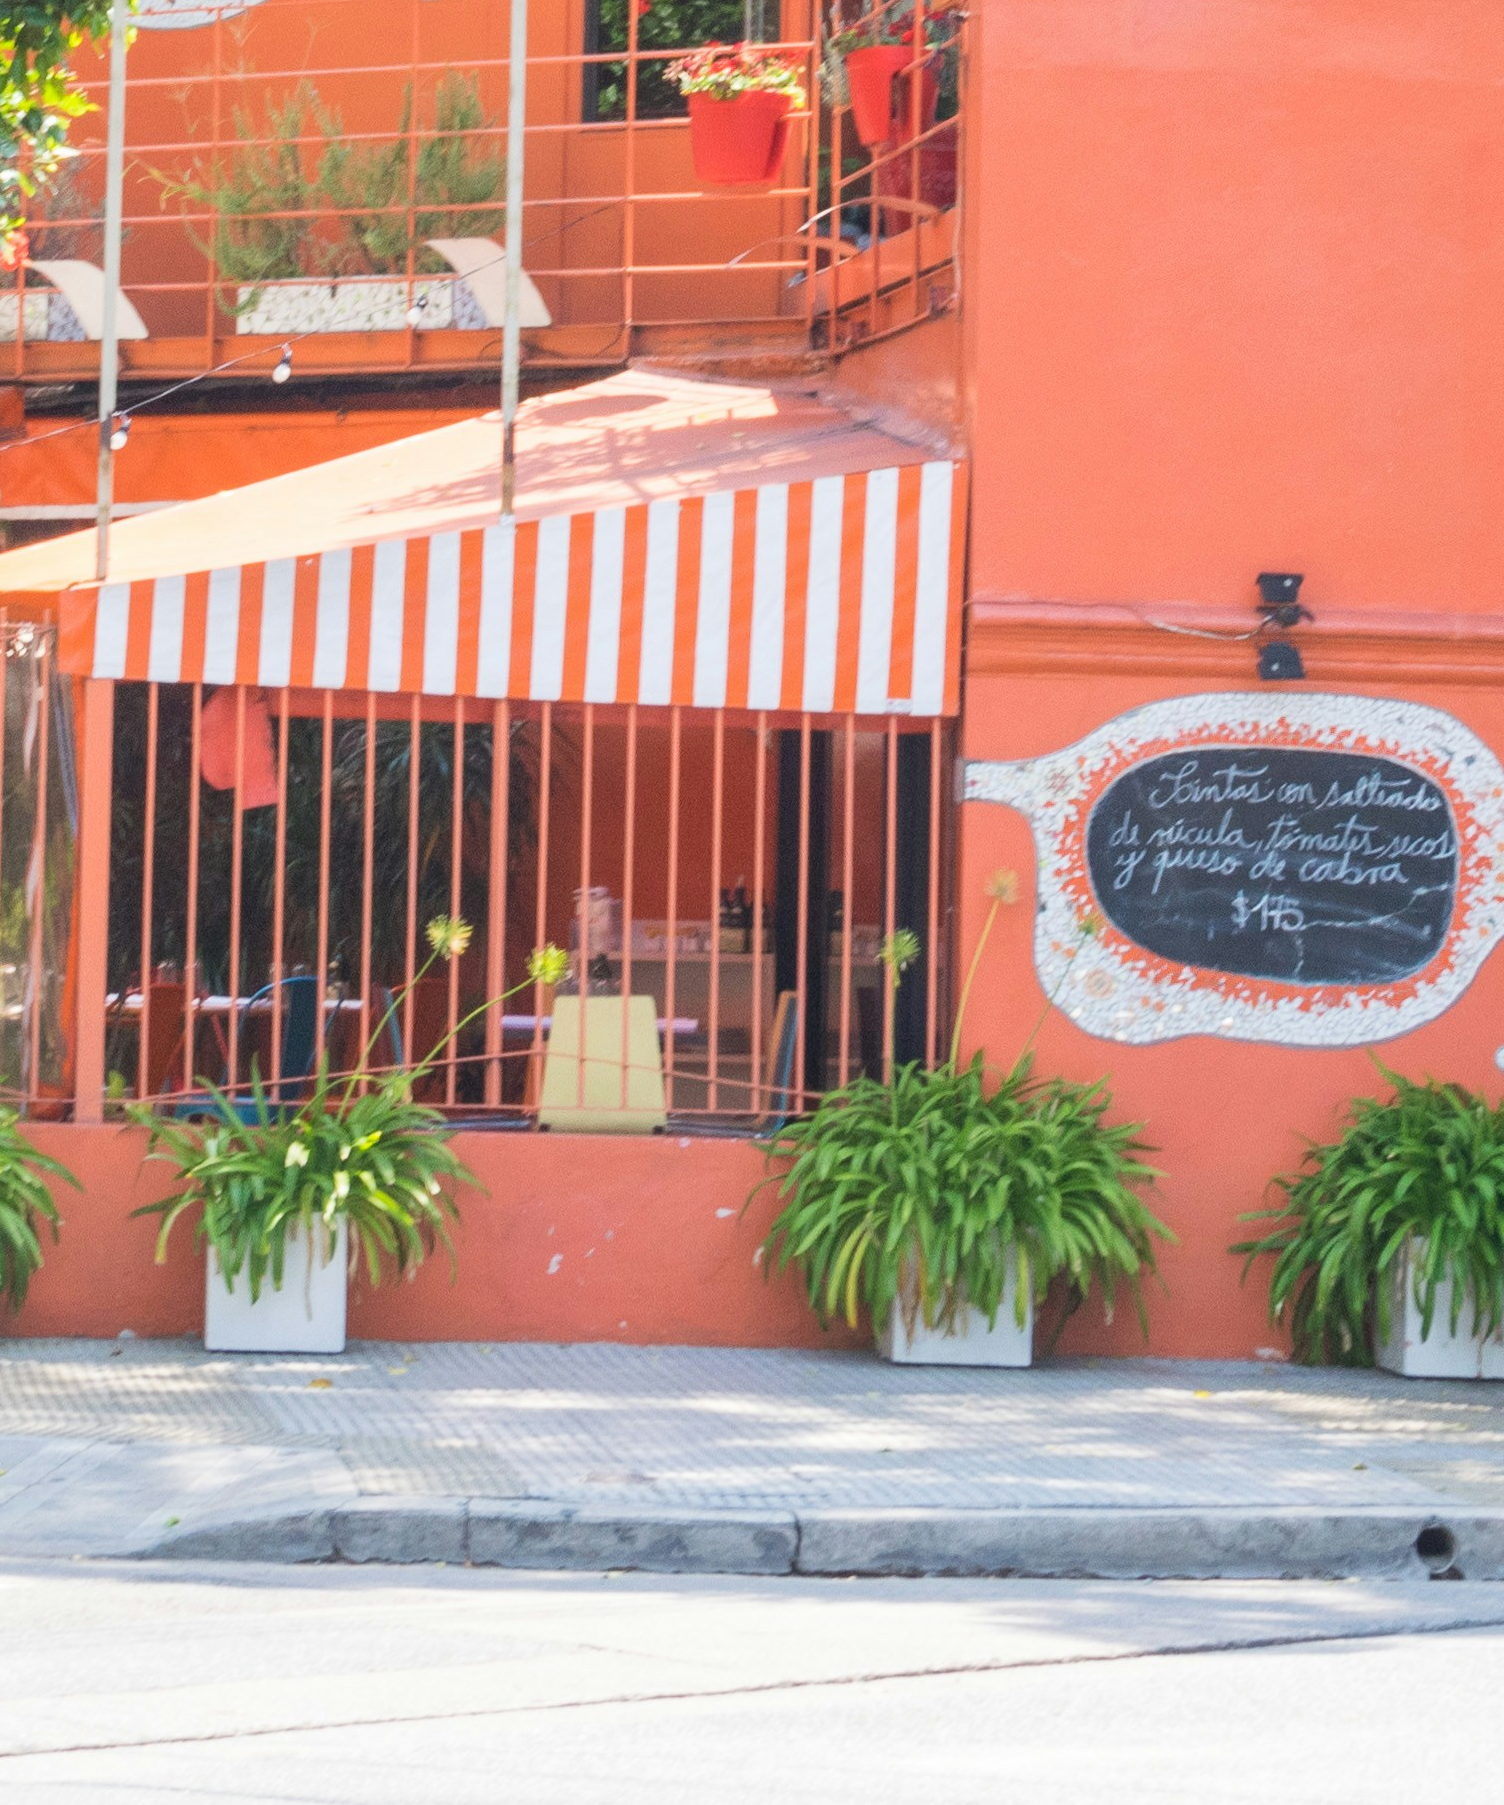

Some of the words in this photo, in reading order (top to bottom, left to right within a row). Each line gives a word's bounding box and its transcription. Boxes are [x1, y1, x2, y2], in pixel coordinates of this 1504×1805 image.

[1276, 781, 1317, 805] con
[1315, 770, 1443, 812] salteado
[1109, 809, 1140, 846] de
[1263, 813, 1385, 856] tomates
[1374, 830, 1456, 860] secos
[1114, 849, 1146, 889] y
[1151, 848, 1243, 894] queso
[1249, 850, 1286, 881] de
[1298, 851, 1409, 885] cabra
[1230, 889, 1304, 931] $175
